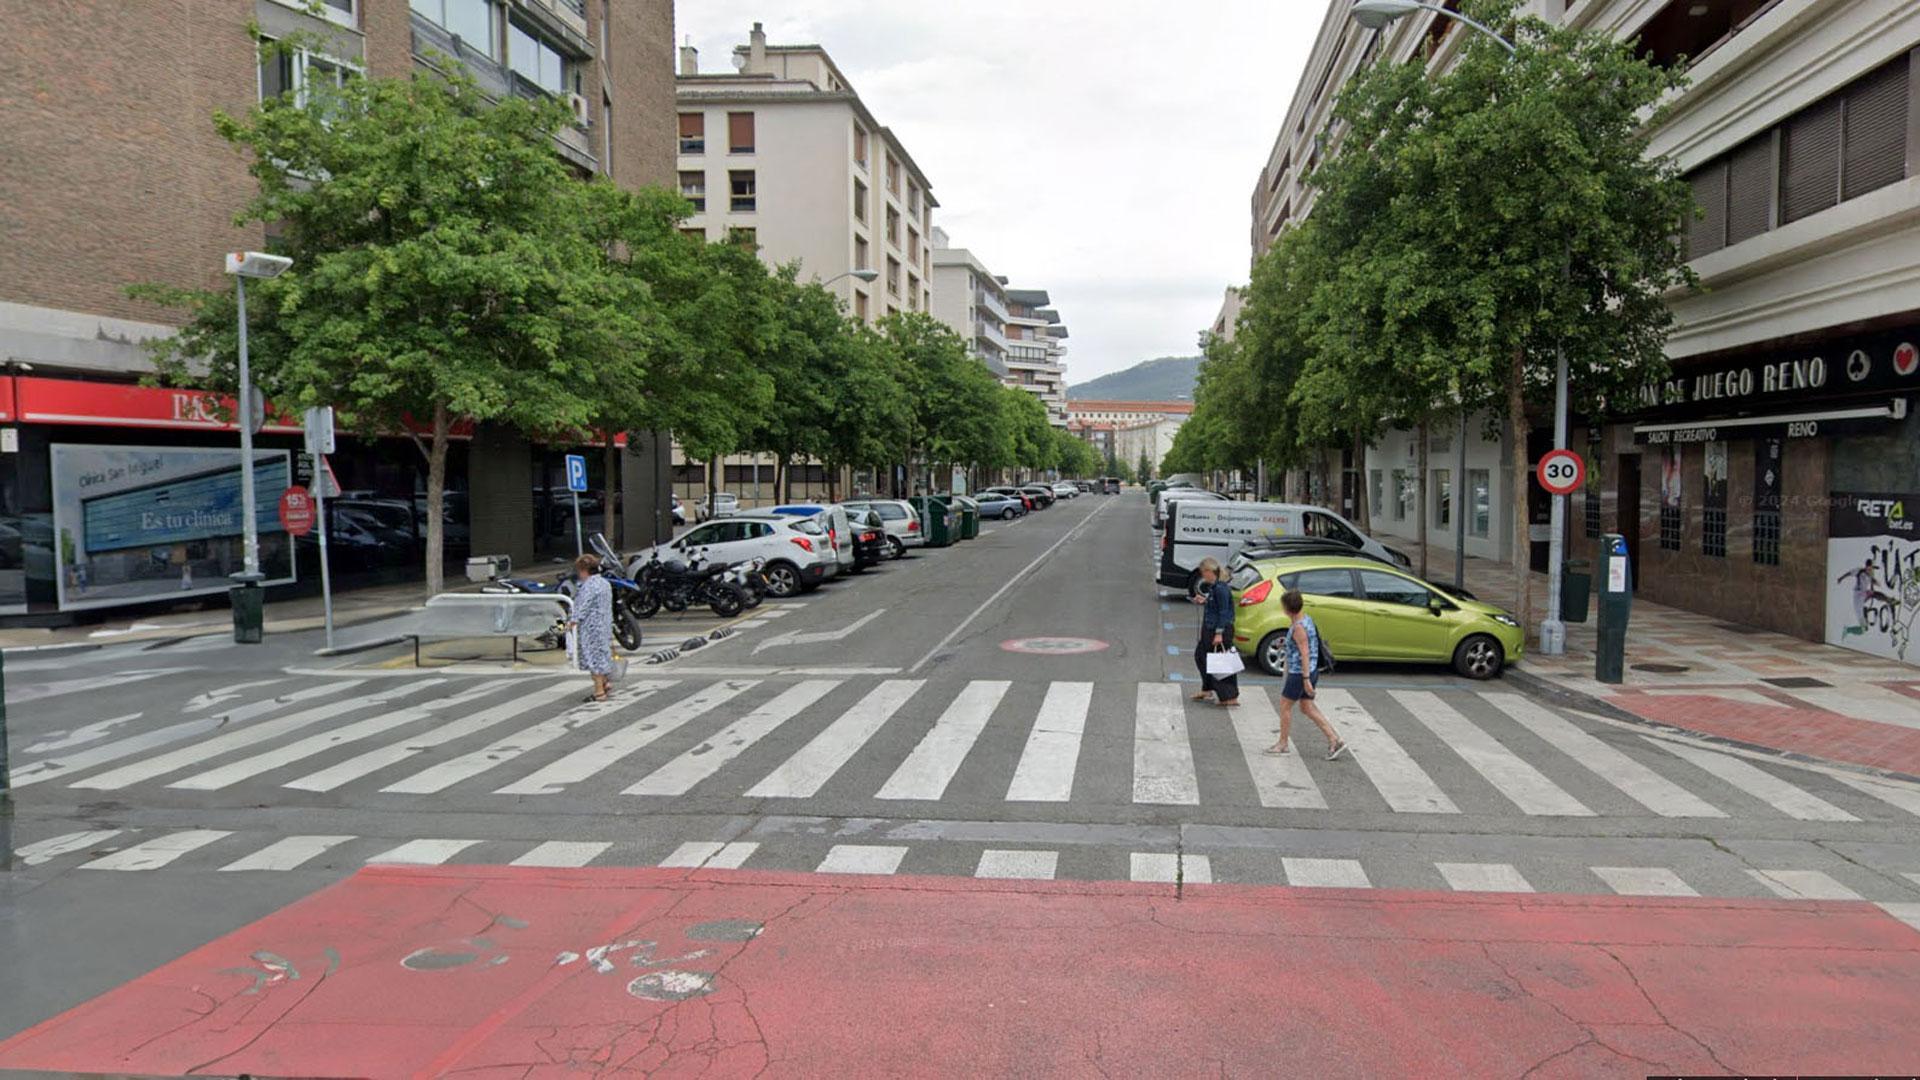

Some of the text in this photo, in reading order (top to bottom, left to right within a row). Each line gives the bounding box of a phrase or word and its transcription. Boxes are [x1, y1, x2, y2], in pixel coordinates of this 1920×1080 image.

[1692, 368, 1753, 401] JUEGO
[1763, 356, 1827, 392] RENO
[1673, 428, 1717, 442] RECREATIVO
[1787, 421, 1818, 438] RENO
[571, 460, 583, 486] P
[1548, 464, 1574, 478] 30
[141, 512, 164, 530] Es
[166, 513, 182, 528] tu
